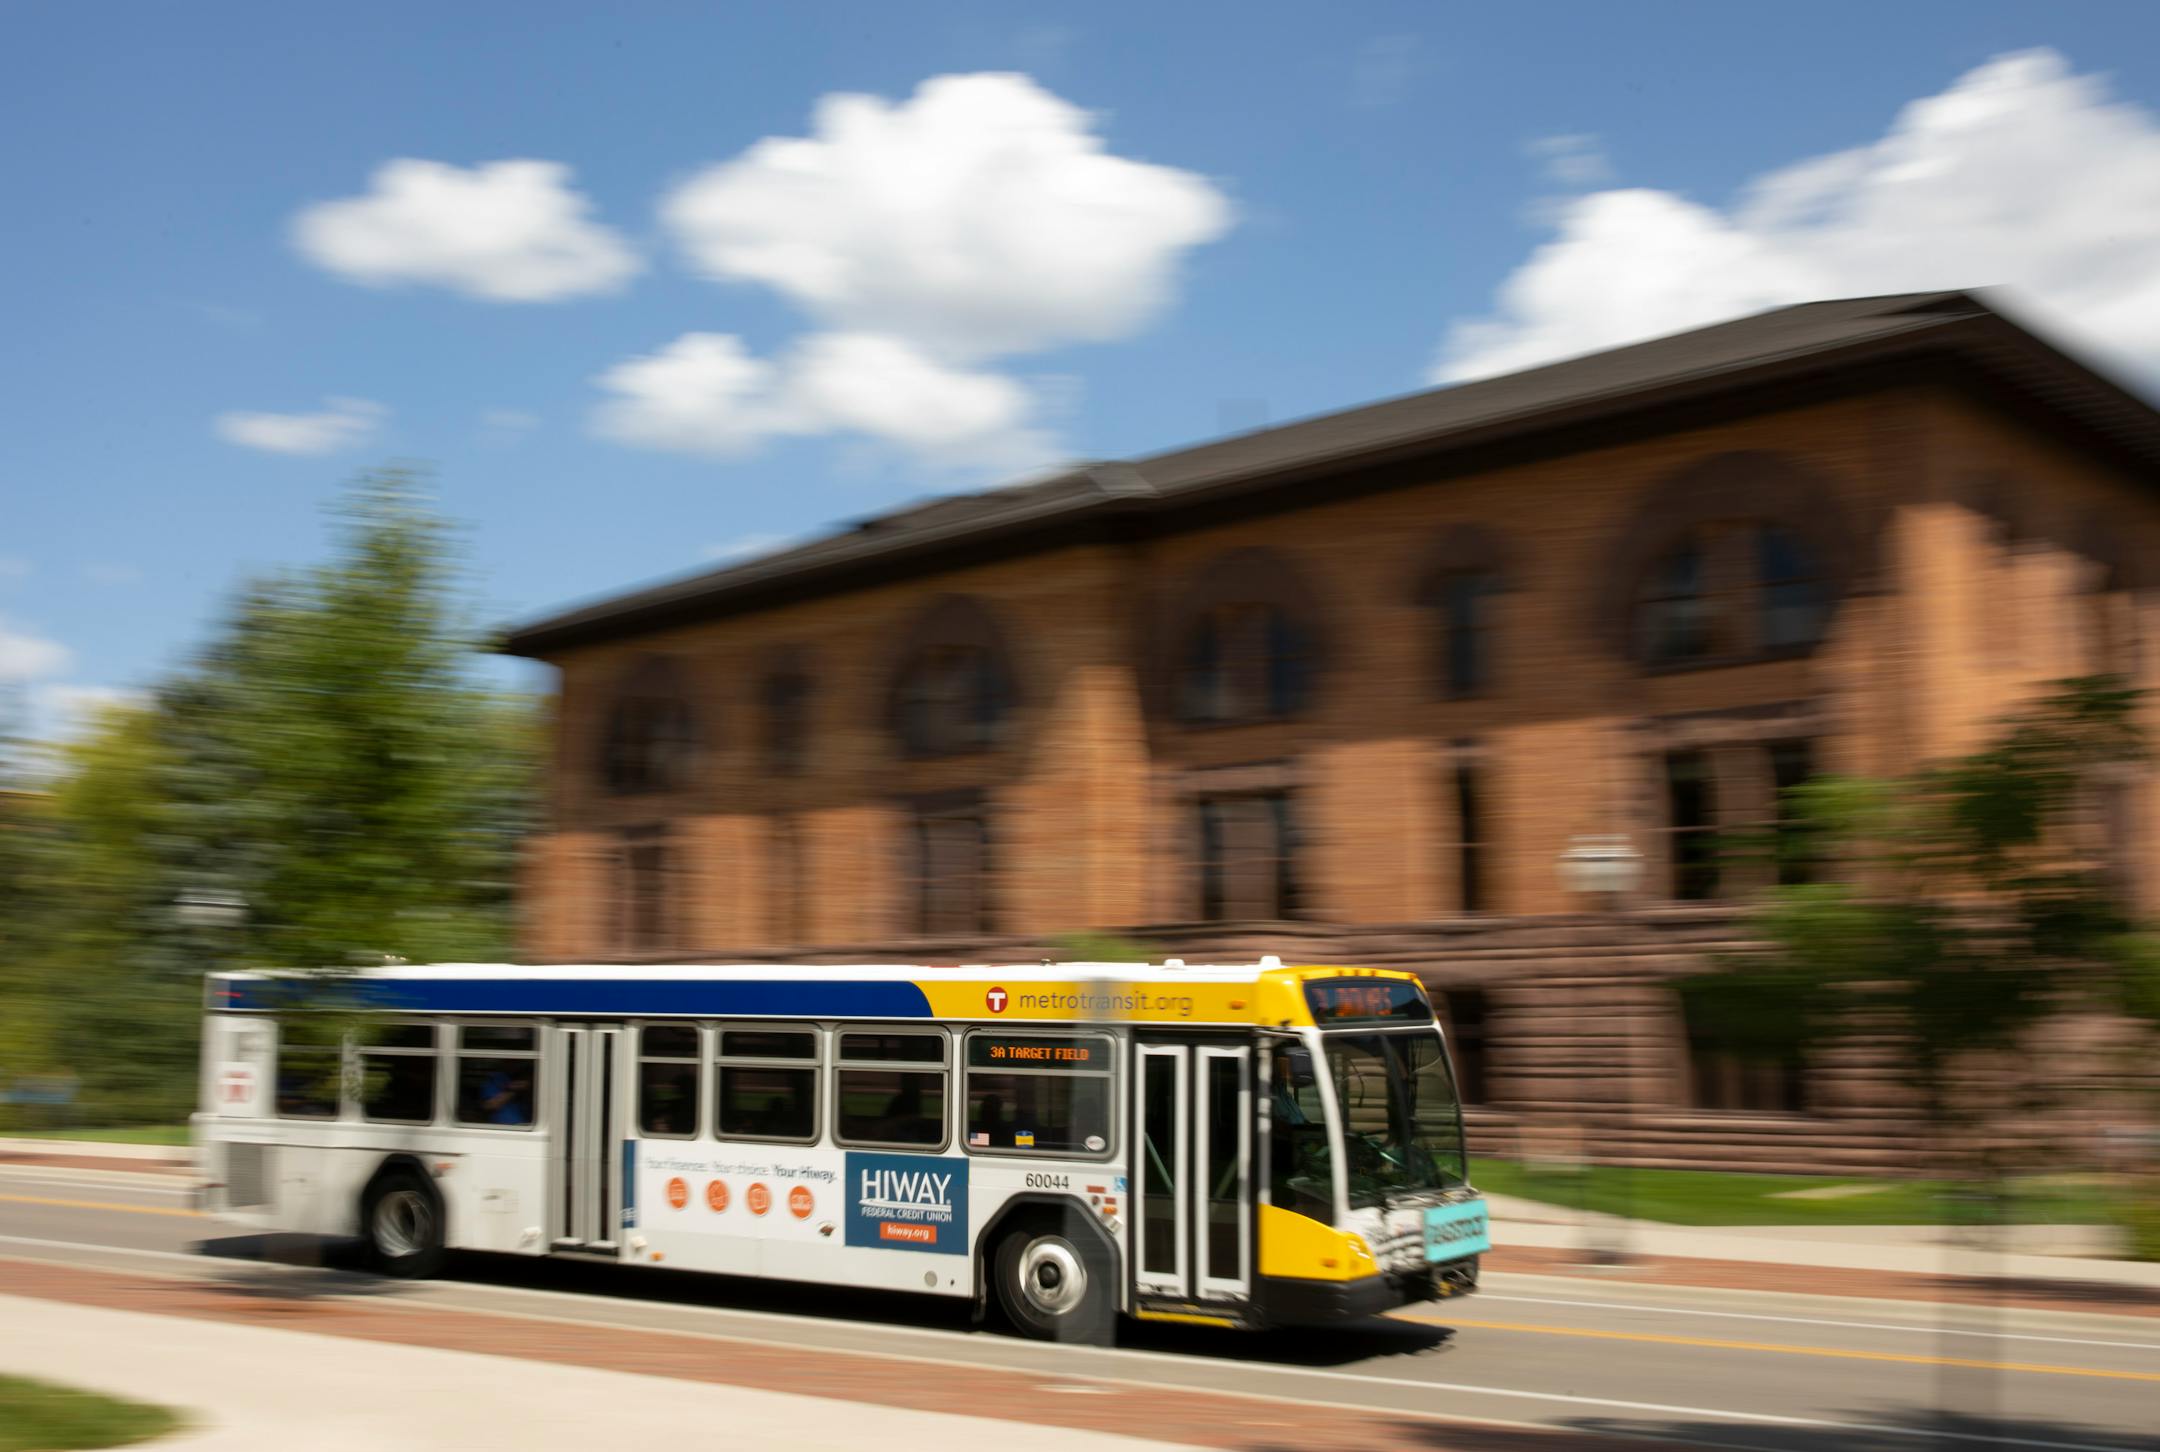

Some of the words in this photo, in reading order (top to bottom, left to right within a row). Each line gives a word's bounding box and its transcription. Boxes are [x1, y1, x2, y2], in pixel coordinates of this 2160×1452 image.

[1019, 991, 1194, 1016] metrotransit.org
[990, 1046, 1006, 1059] 3A
[1009, 1046, 1053, 1060] TARGET
[1055, 1047, 1090, 1061] FIELD
[772, 1163, 798, 1178] Your
[1025, 1172, 1070, 1189] 60044
[861, 1206, 896, 1219] FEDERAL
[896, 1208, 925, 1221] CREDIT
[926, 1211, 952, 1223] UNION
[887, 1224, 930, 1241] hiway.org
